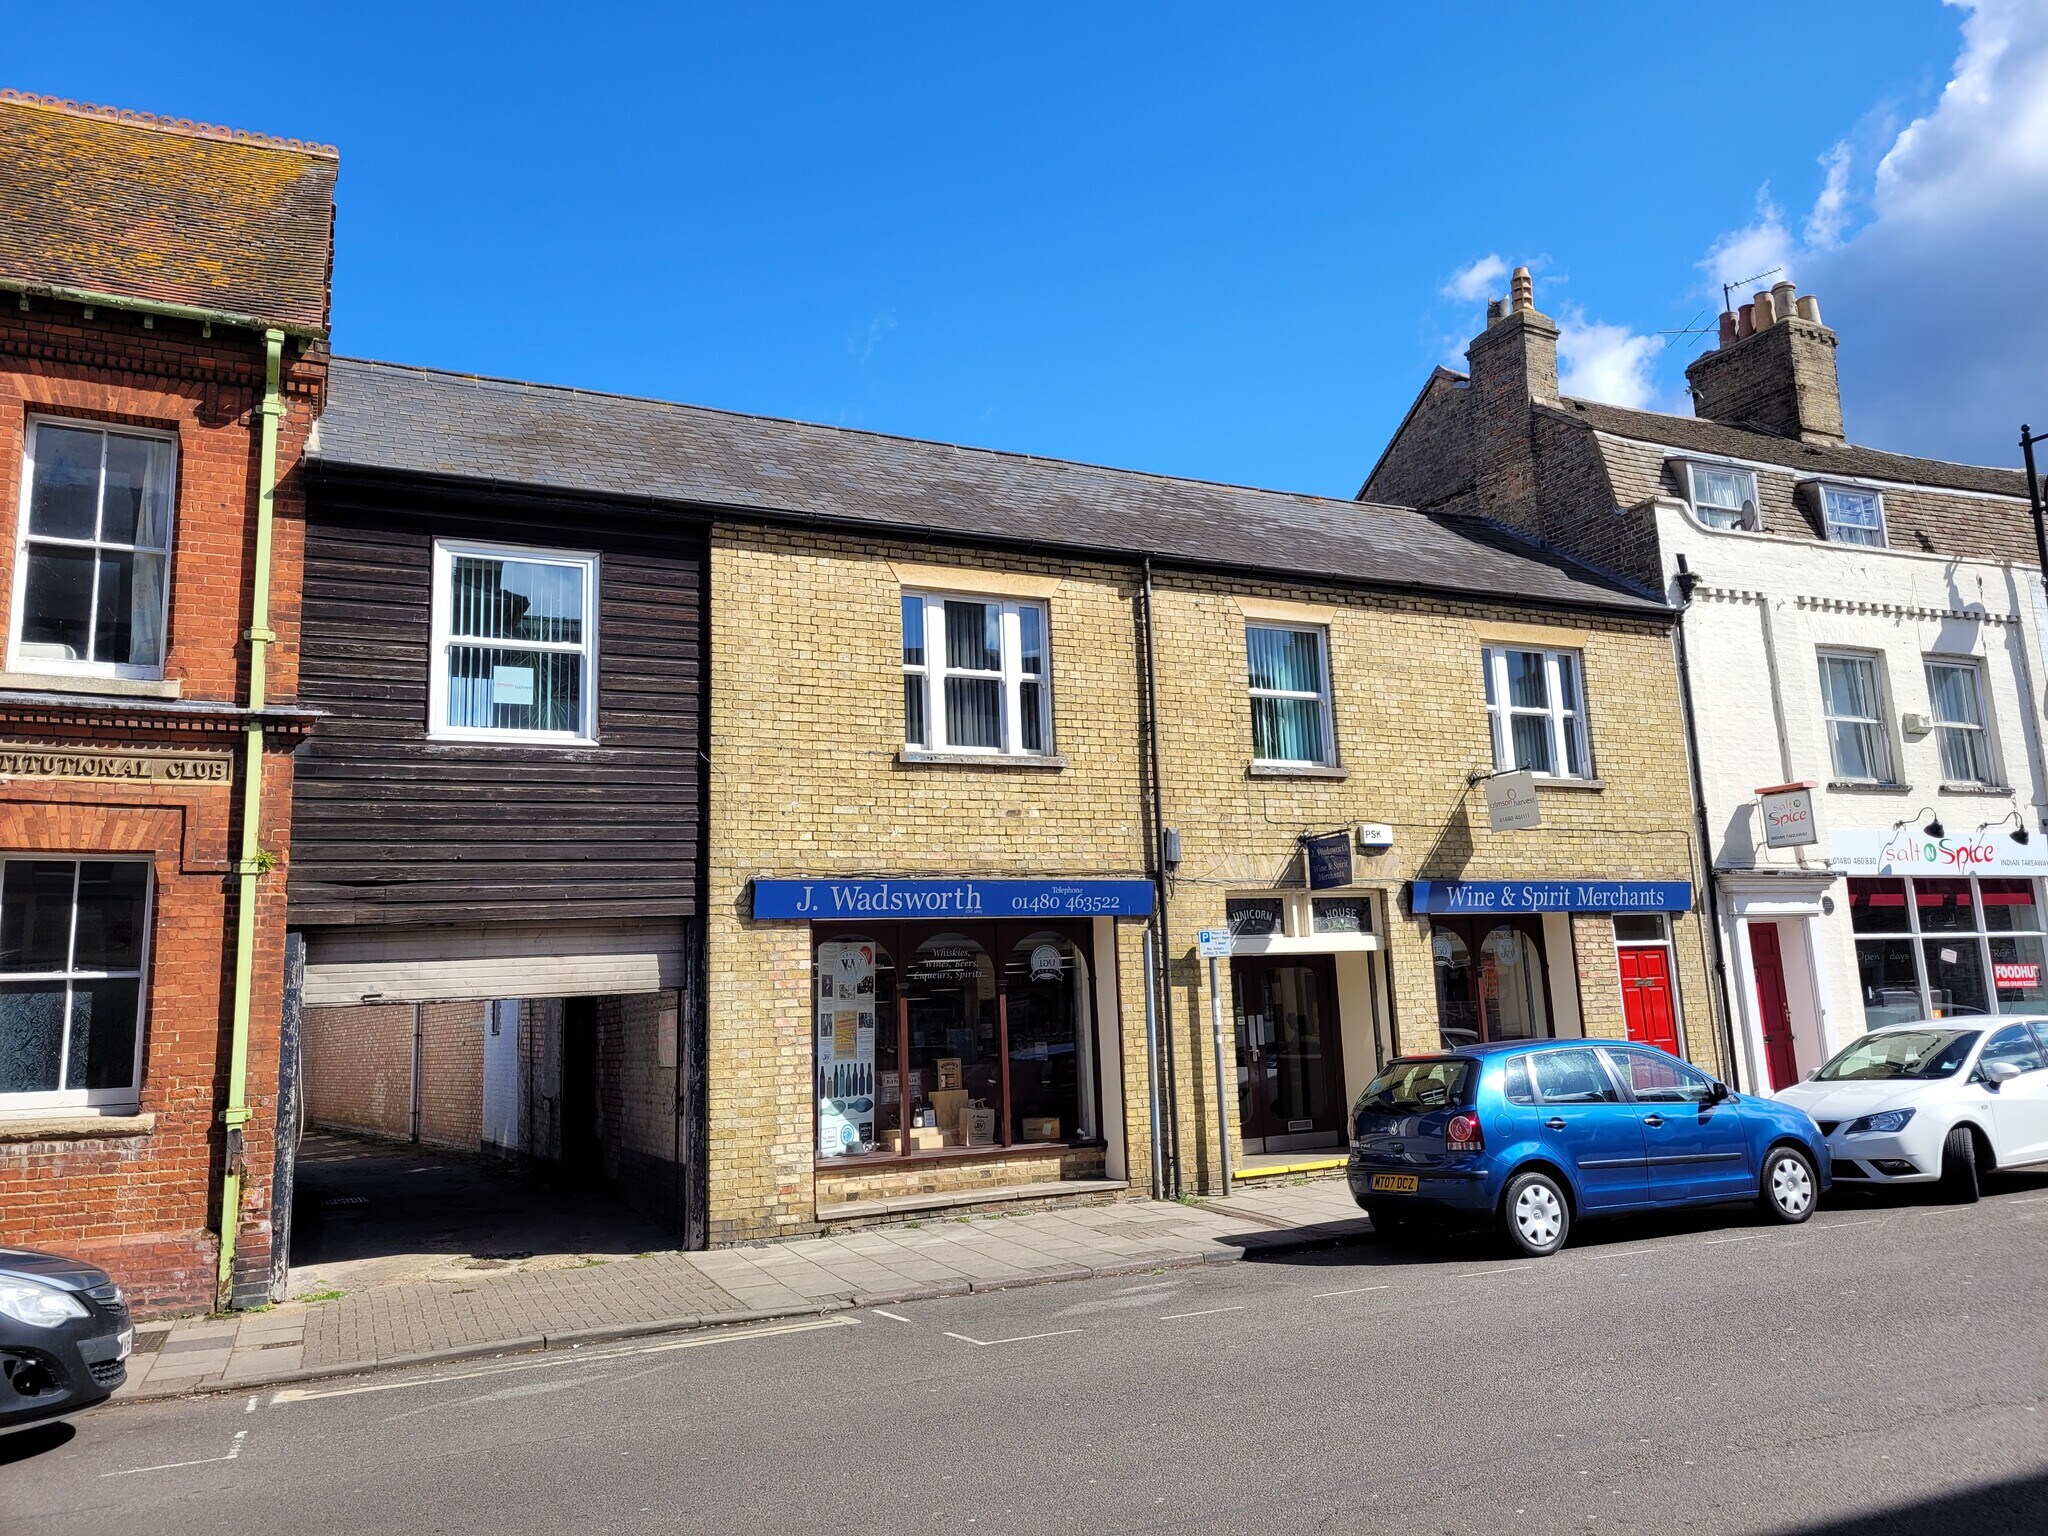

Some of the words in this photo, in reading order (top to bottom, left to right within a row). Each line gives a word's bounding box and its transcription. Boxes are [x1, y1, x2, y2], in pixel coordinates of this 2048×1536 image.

[166, 762, 228, 780] CLUB
[1489, 800, 1513, 809] crimson
[1513, 797, 1536, 807] harvest
[1773, 799, 1792, 811] salt
[1499, 815, 1514, 823] 01480
[1768, 809, 1807, 829] Spice
[1365, 830, 1382, 839] PSK
[1316, 842, 1349, 857] Wadsworth
[1885, 837, 1921, 862] salt
[1938, 837, 1994, 873] Spice
[1313, 864, 1328, 873] Wine
[1333, 859, 1349, 870] Spirit
[1832, 856, 1851, 866] 01480
[2000, 859, 2020, 867] INDIAN
[1318, 870, 1345, 881] Merchants
[1051, 886, 1084, 895] Telephone
[796, 886, 818, 912] J.
[830, 884, 982, 912] Wadsworth
[1011, 893, 1060, 913] 01480
[1065, 893, 1120, 913] 463522
[1446, 885, 1495, 907] Wine
[1501, 885, 1516, 907] &
[1522, 885, 1571, 911] Spirit
[1576, 885, 1664, 907] Merchants
[1232, 908, 1273, 922] UNICORN
[1325, 907, 1357, 919] HOUSE
[932, 947, 971, 957] Whiskies,
[1857, 950, 1880, 964] Open
[1889, 949, 1910, 963] days
[924, 959, 952, 968] Wines,
[954, 960, 979, 968] Beers,
[913, 971, 953, 982] Liqueurs,
[1995, 965, 2040, 979] FOODHUB
[1374, 1177, 1396, 1189] MT07
[1397, 1177, 1415, 1190] DCZ
